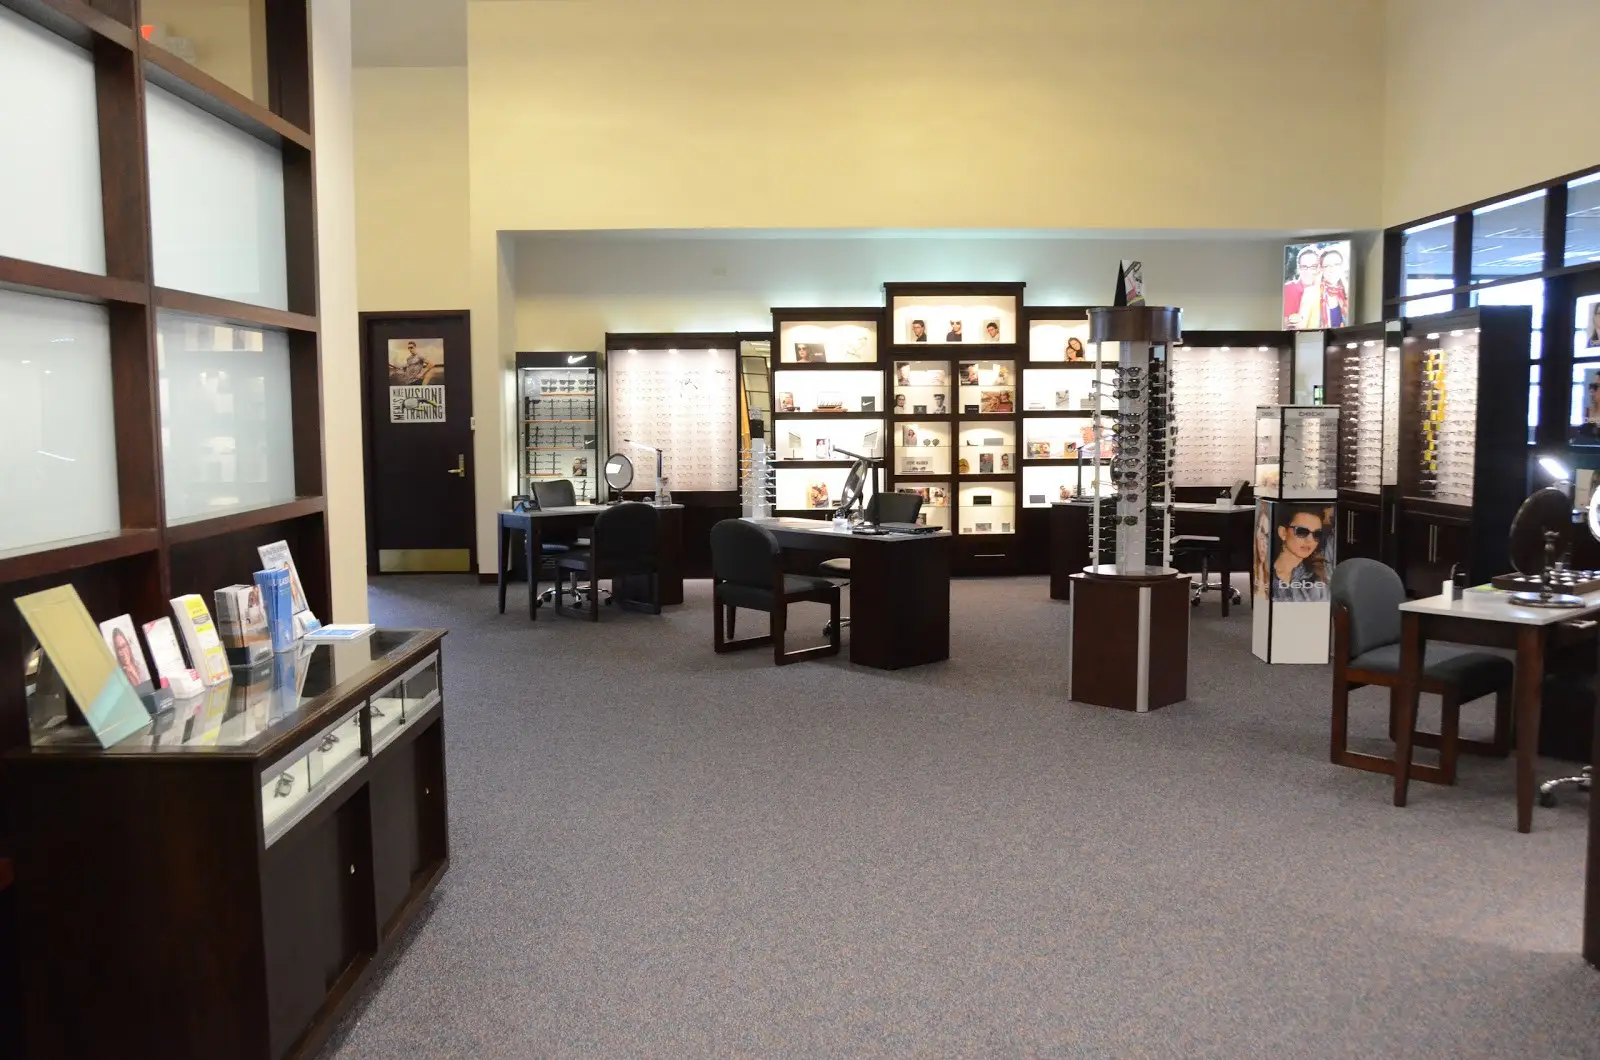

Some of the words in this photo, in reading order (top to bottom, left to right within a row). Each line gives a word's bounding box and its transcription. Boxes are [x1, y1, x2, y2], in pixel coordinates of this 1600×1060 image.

[404, 387, 437, 402] VISION
[405, 405, 443, 420] TRAINING
[1278, 579, 1326, 589] bebe
